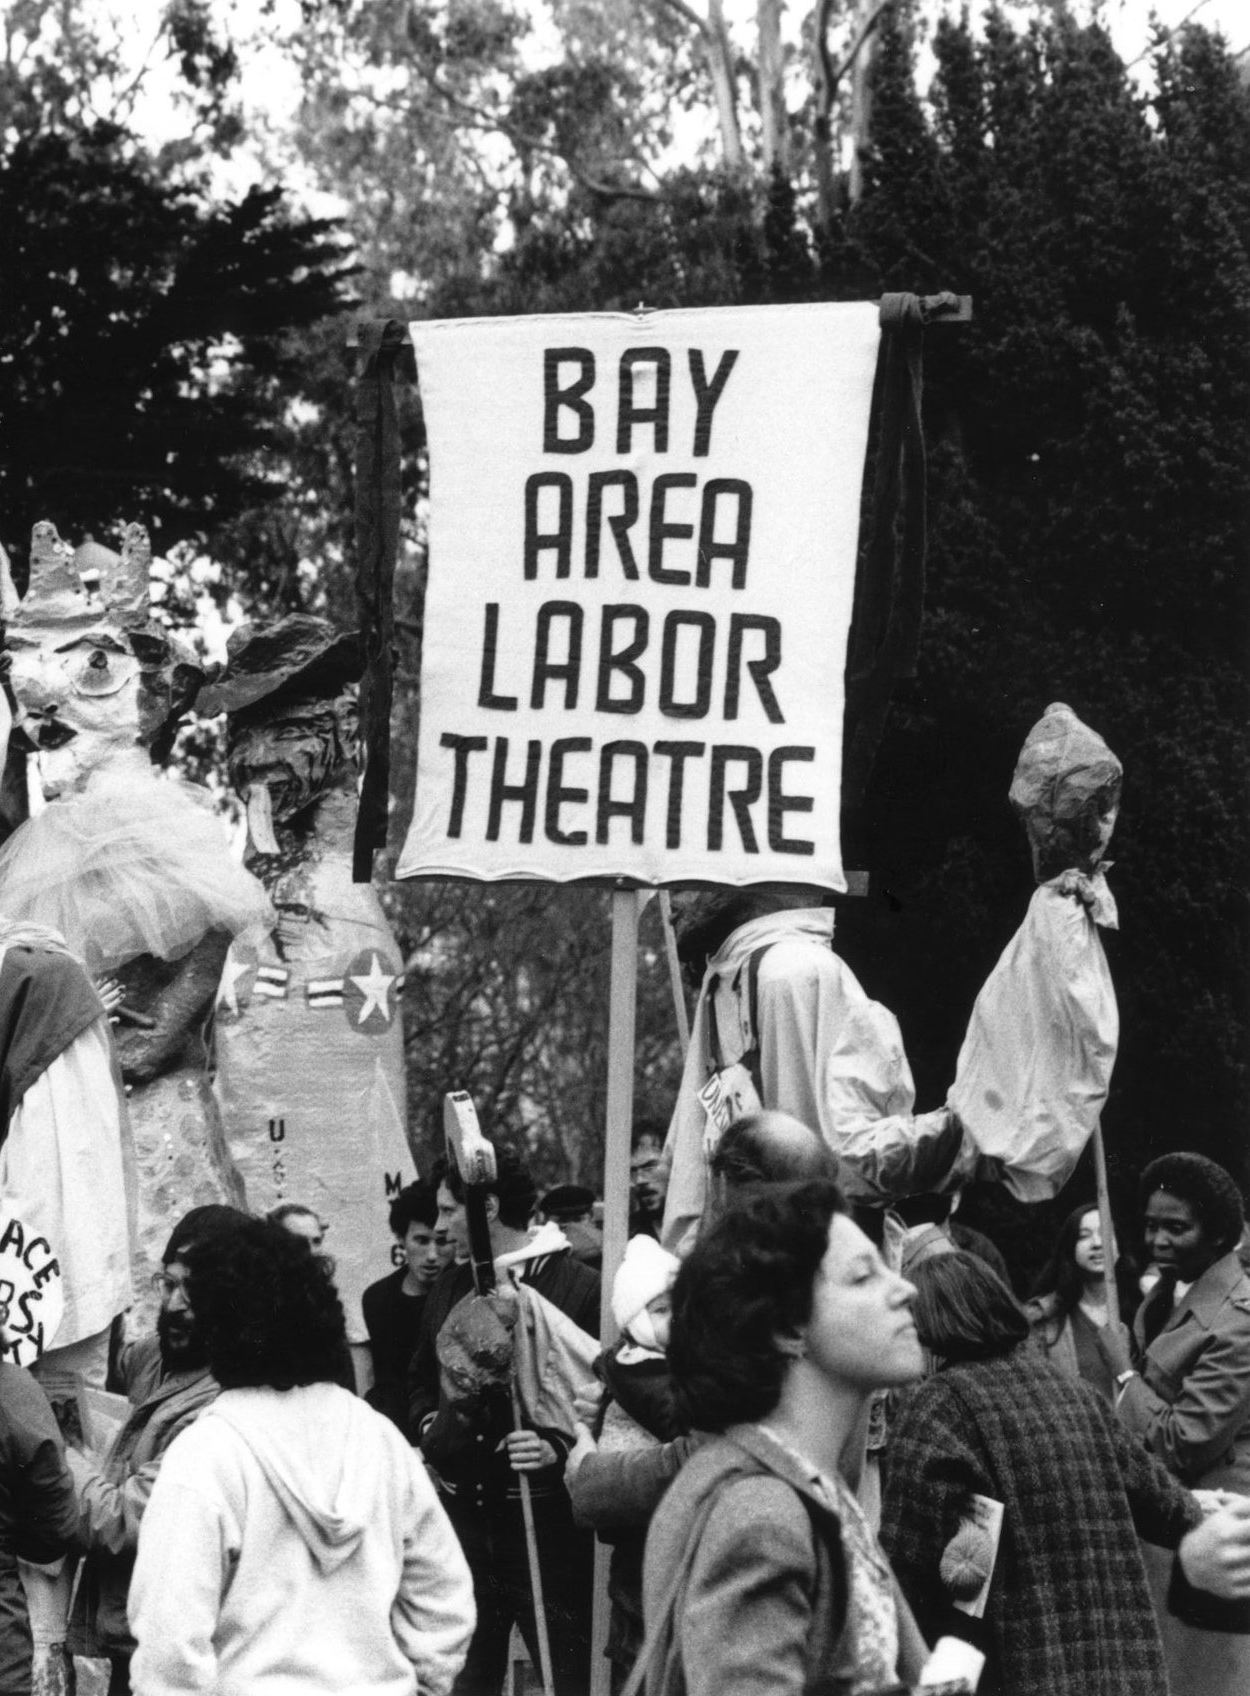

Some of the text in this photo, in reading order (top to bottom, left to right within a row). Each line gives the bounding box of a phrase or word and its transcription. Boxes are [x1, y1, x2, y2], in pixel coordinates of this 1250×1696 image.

[543, 346, 740, 458] BAY
[523, 469, 753, 590] AREA
[477, 600, 786, 724] LABOR
[439, 732, 815, 856] THEATRE
[7, 1321, 44, 1367] TY
